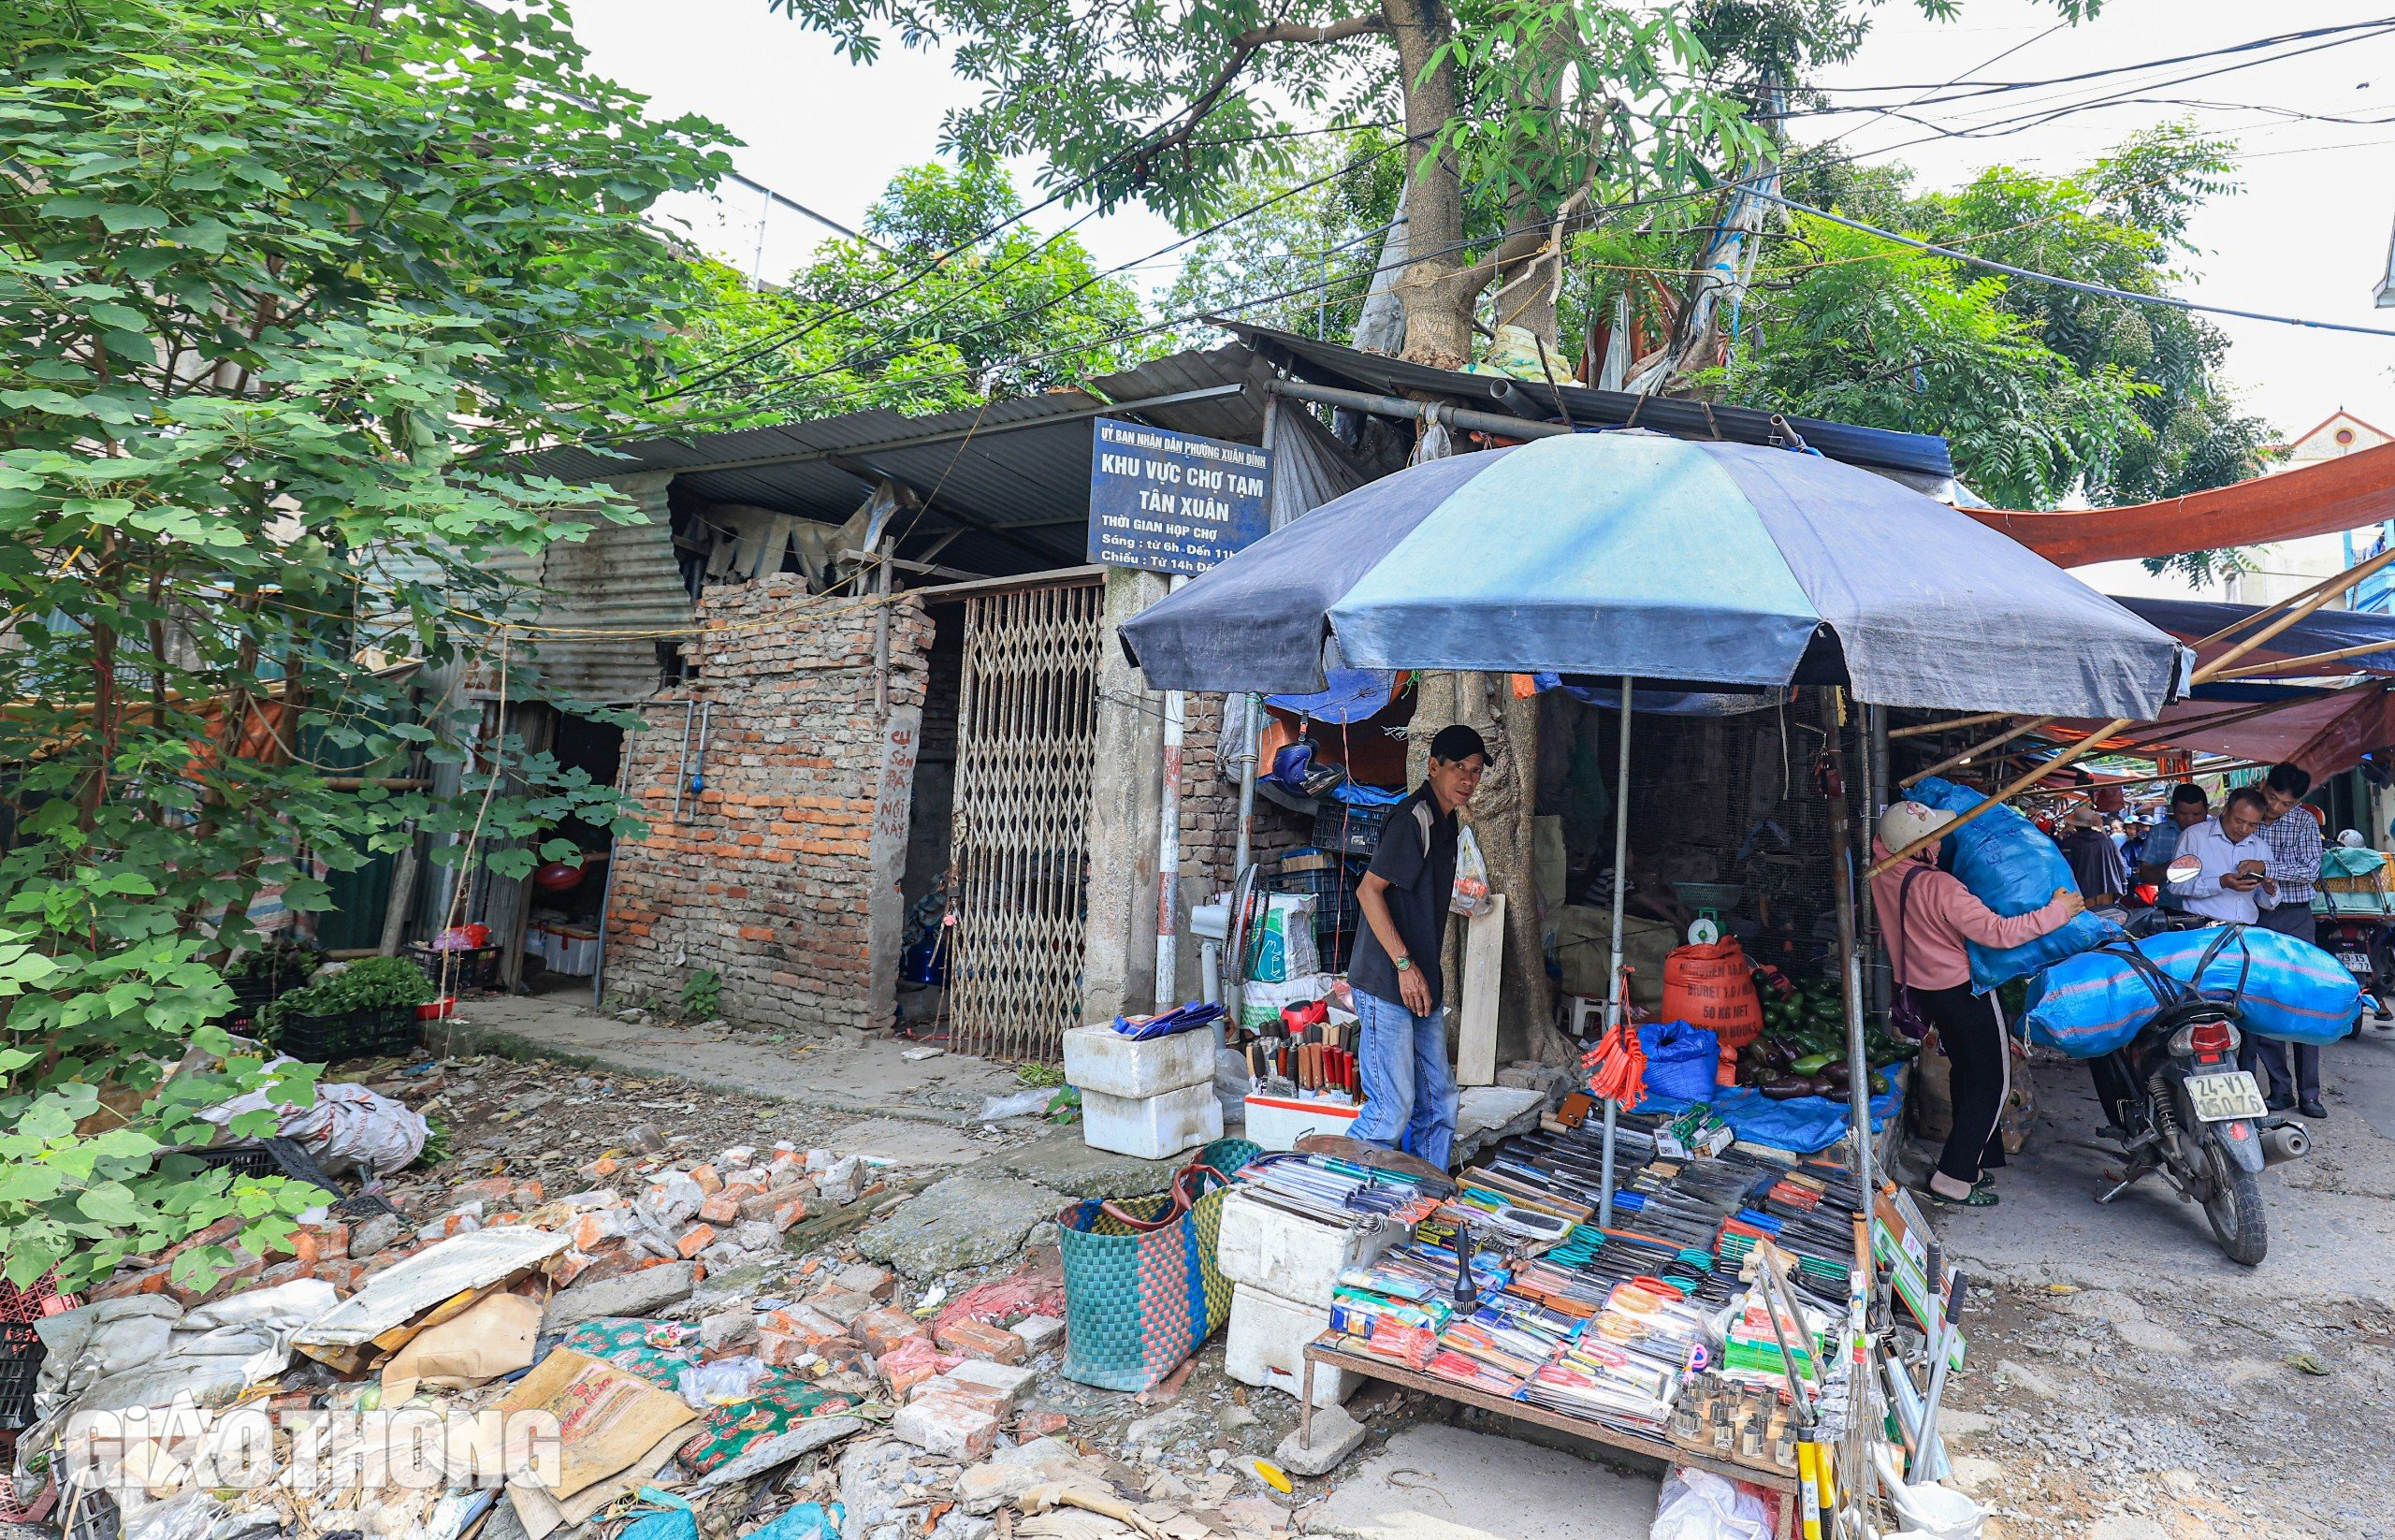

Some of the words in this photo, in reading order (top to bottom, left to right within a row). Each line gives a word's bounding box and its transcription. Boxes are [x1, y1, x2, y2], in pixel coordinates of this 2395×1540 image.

[1101, 424, 1114, 441] UỶ
[1115, 429, 1135, 444] BAN
[1137, 433, 1162, 449] NHÂN
[1164, 437, 1183, 453] DÂN
[1184, 442, 1219, 459] PHƯỜNG
[1221, 448, 1244, 464] XUÂN
[1245, 450, 1266, 468] ĐỈNH
[1101, 453, 1140, 477] KHU
[1145, 459, 1182, 486] VỰC
[1186, 467, 1224, 494] CHỢ
[1227, 473, 1264, 499] TẠM
[1139, 488, 1175, 514] TÂN
[1180, 497, 1229, 522] XUÂN
[1102, 514, 1130, 529] THỜI
[1133, 518, 1163, 533] GIAN
[1166, 523, 1190, 538] HỌP
[1193, 527, 1218, 543] CHỢ
[1101, 533, 1135, 549] Sáng
[1146, 540, 1162, 550] từ
[1163, 542, 1180, 553] 6h
[1186, 544, 1212, 557] Đến
[1101, 550, 1139, 564] Chiều
[1150, 556, 1167, 568] Từ
[1170, 558, 1194, 571] 14h
[1197, 561, 1216, 573] Đế
[1703, 1006, 1717, 1020] 50
[1718, 1006, 1732, 1020] KG
[1733, 1004, 1749, 1019] NET
[2196, 1075, 2246, 1097] 24-V1
